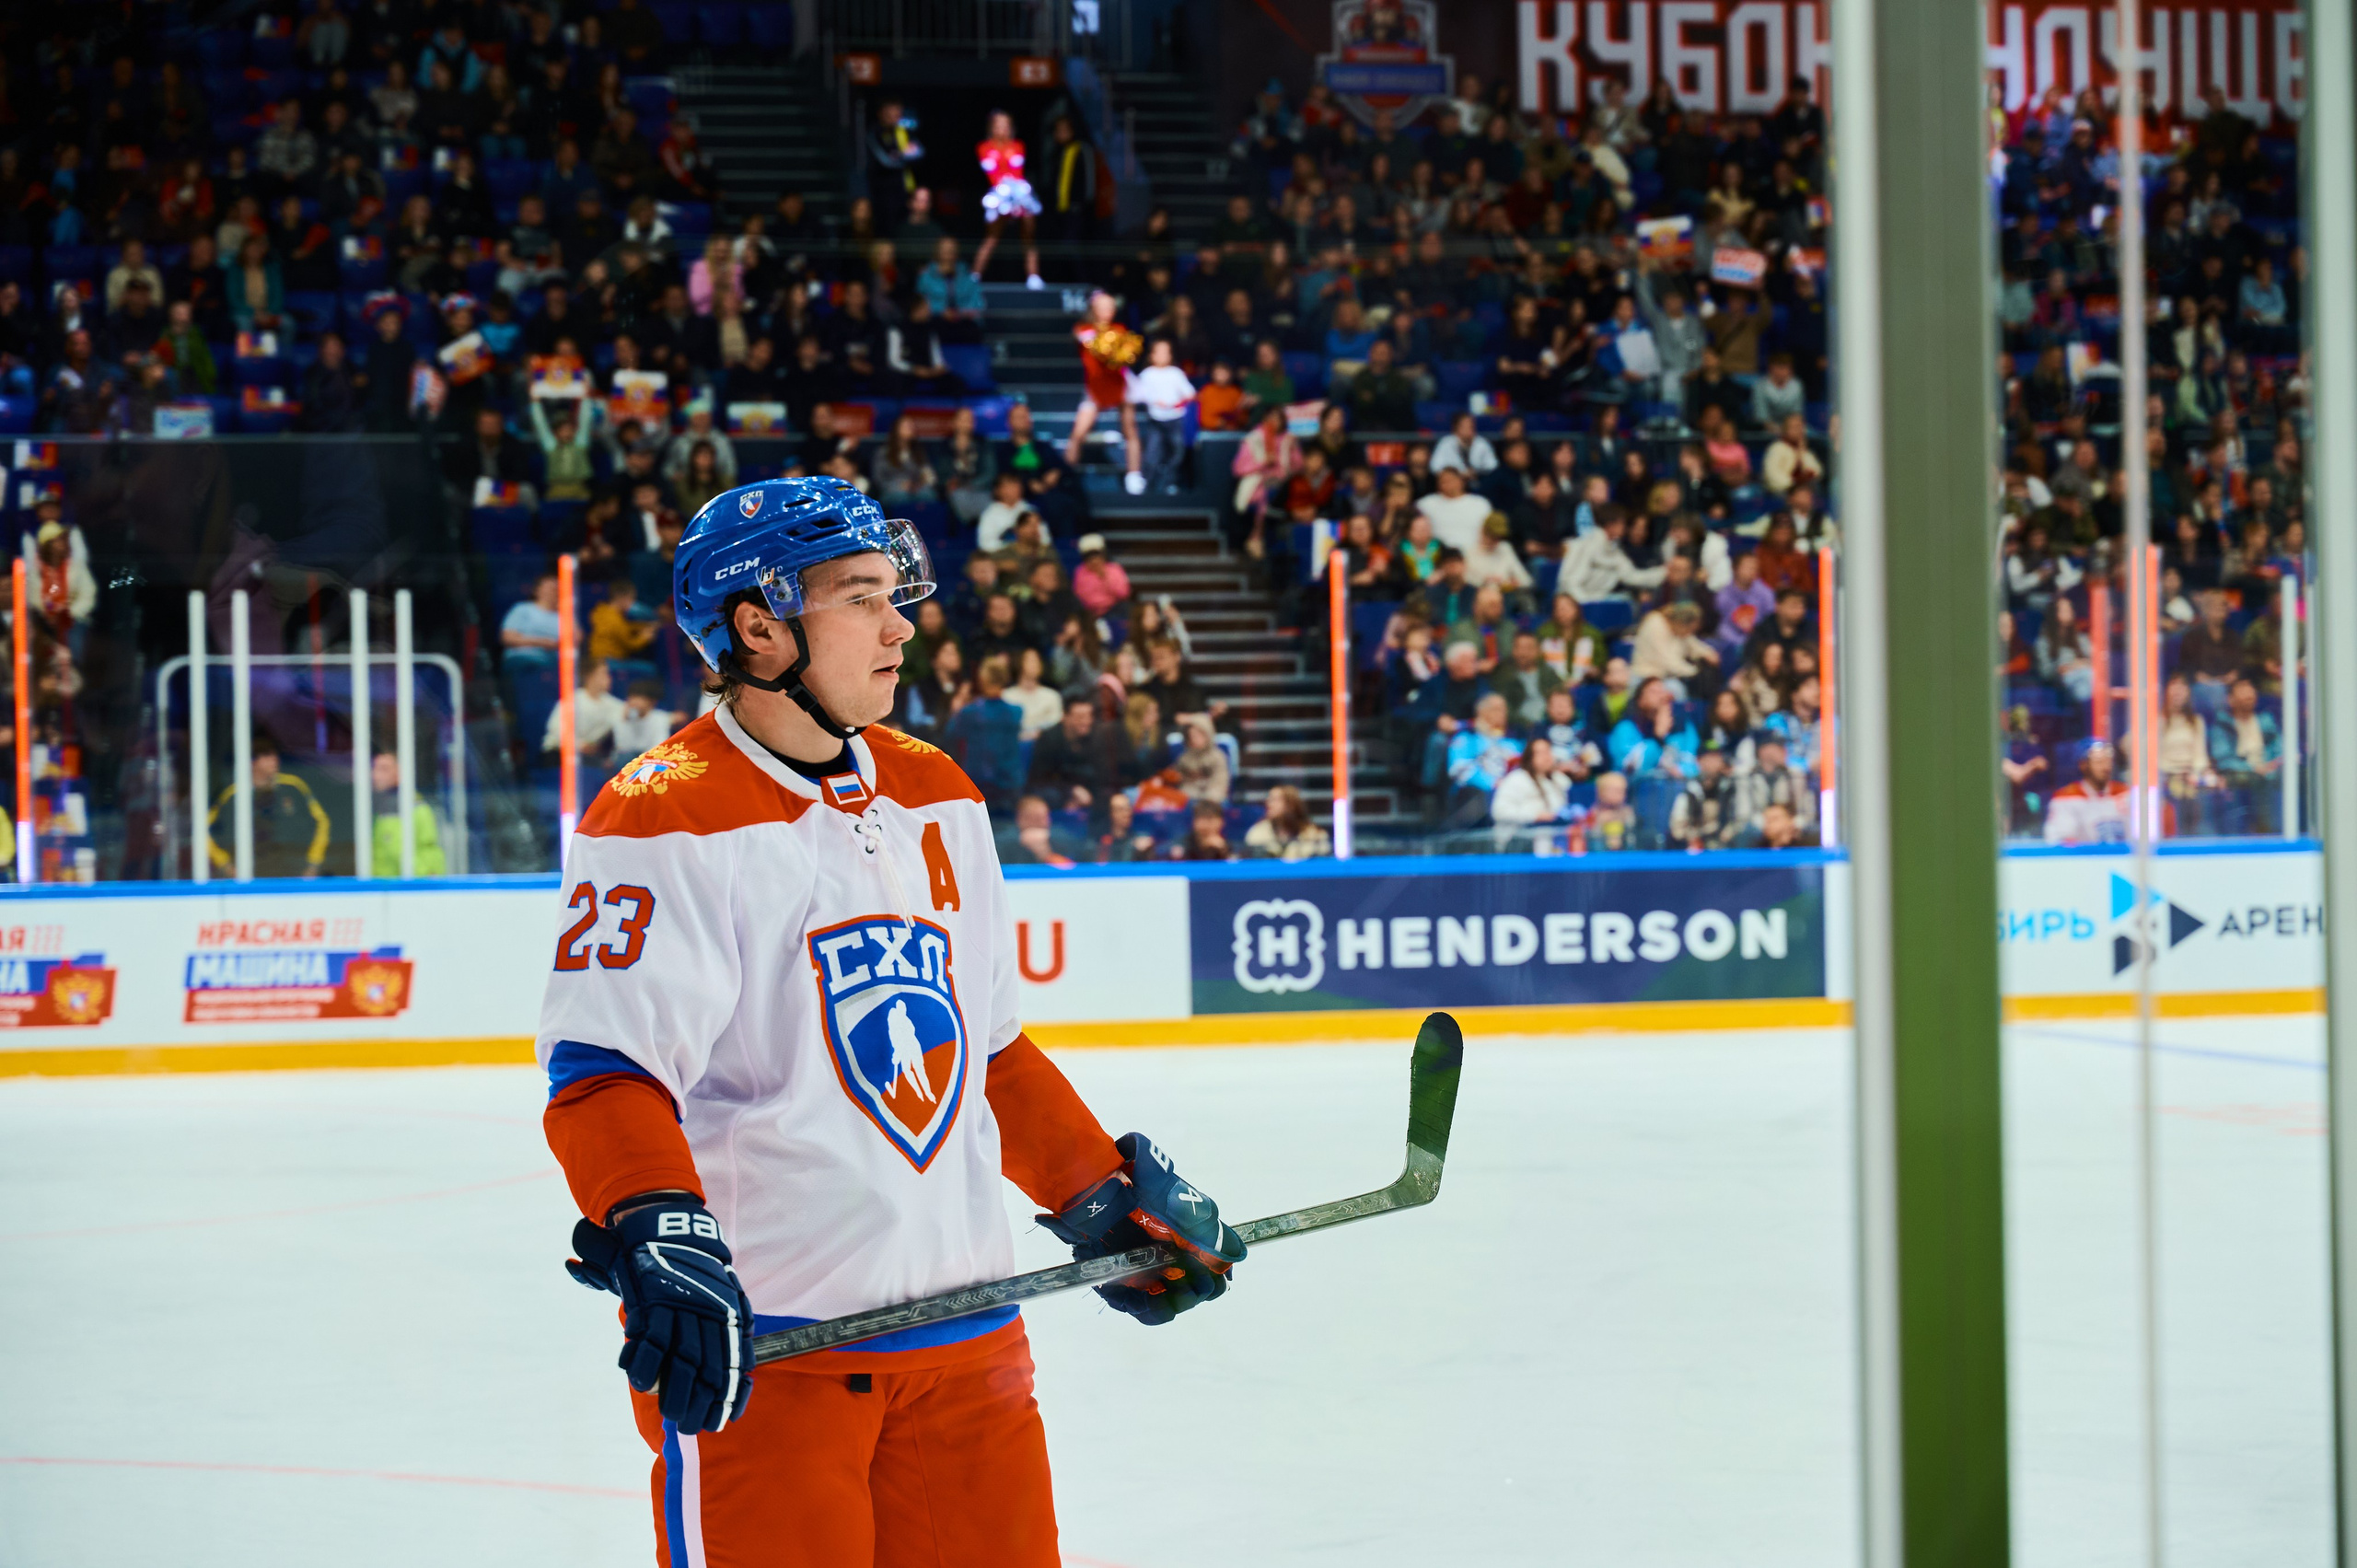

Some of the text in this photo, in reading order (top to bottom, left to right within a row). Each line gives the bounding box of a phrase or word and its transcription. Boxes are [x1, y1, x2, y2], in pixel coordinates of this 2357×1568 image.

[714, 556, 761, 581] CCM
[921, 821, 961, 912] A
[197, 919, 327, 946] КРАСНАЯ
[553, 880, 656, 972] 23
[1337, 908, 1788, 970] HENDERSON
[190, 952, 330, 988] МАШИНА
[817, 925, 949, 996] СХЛ
